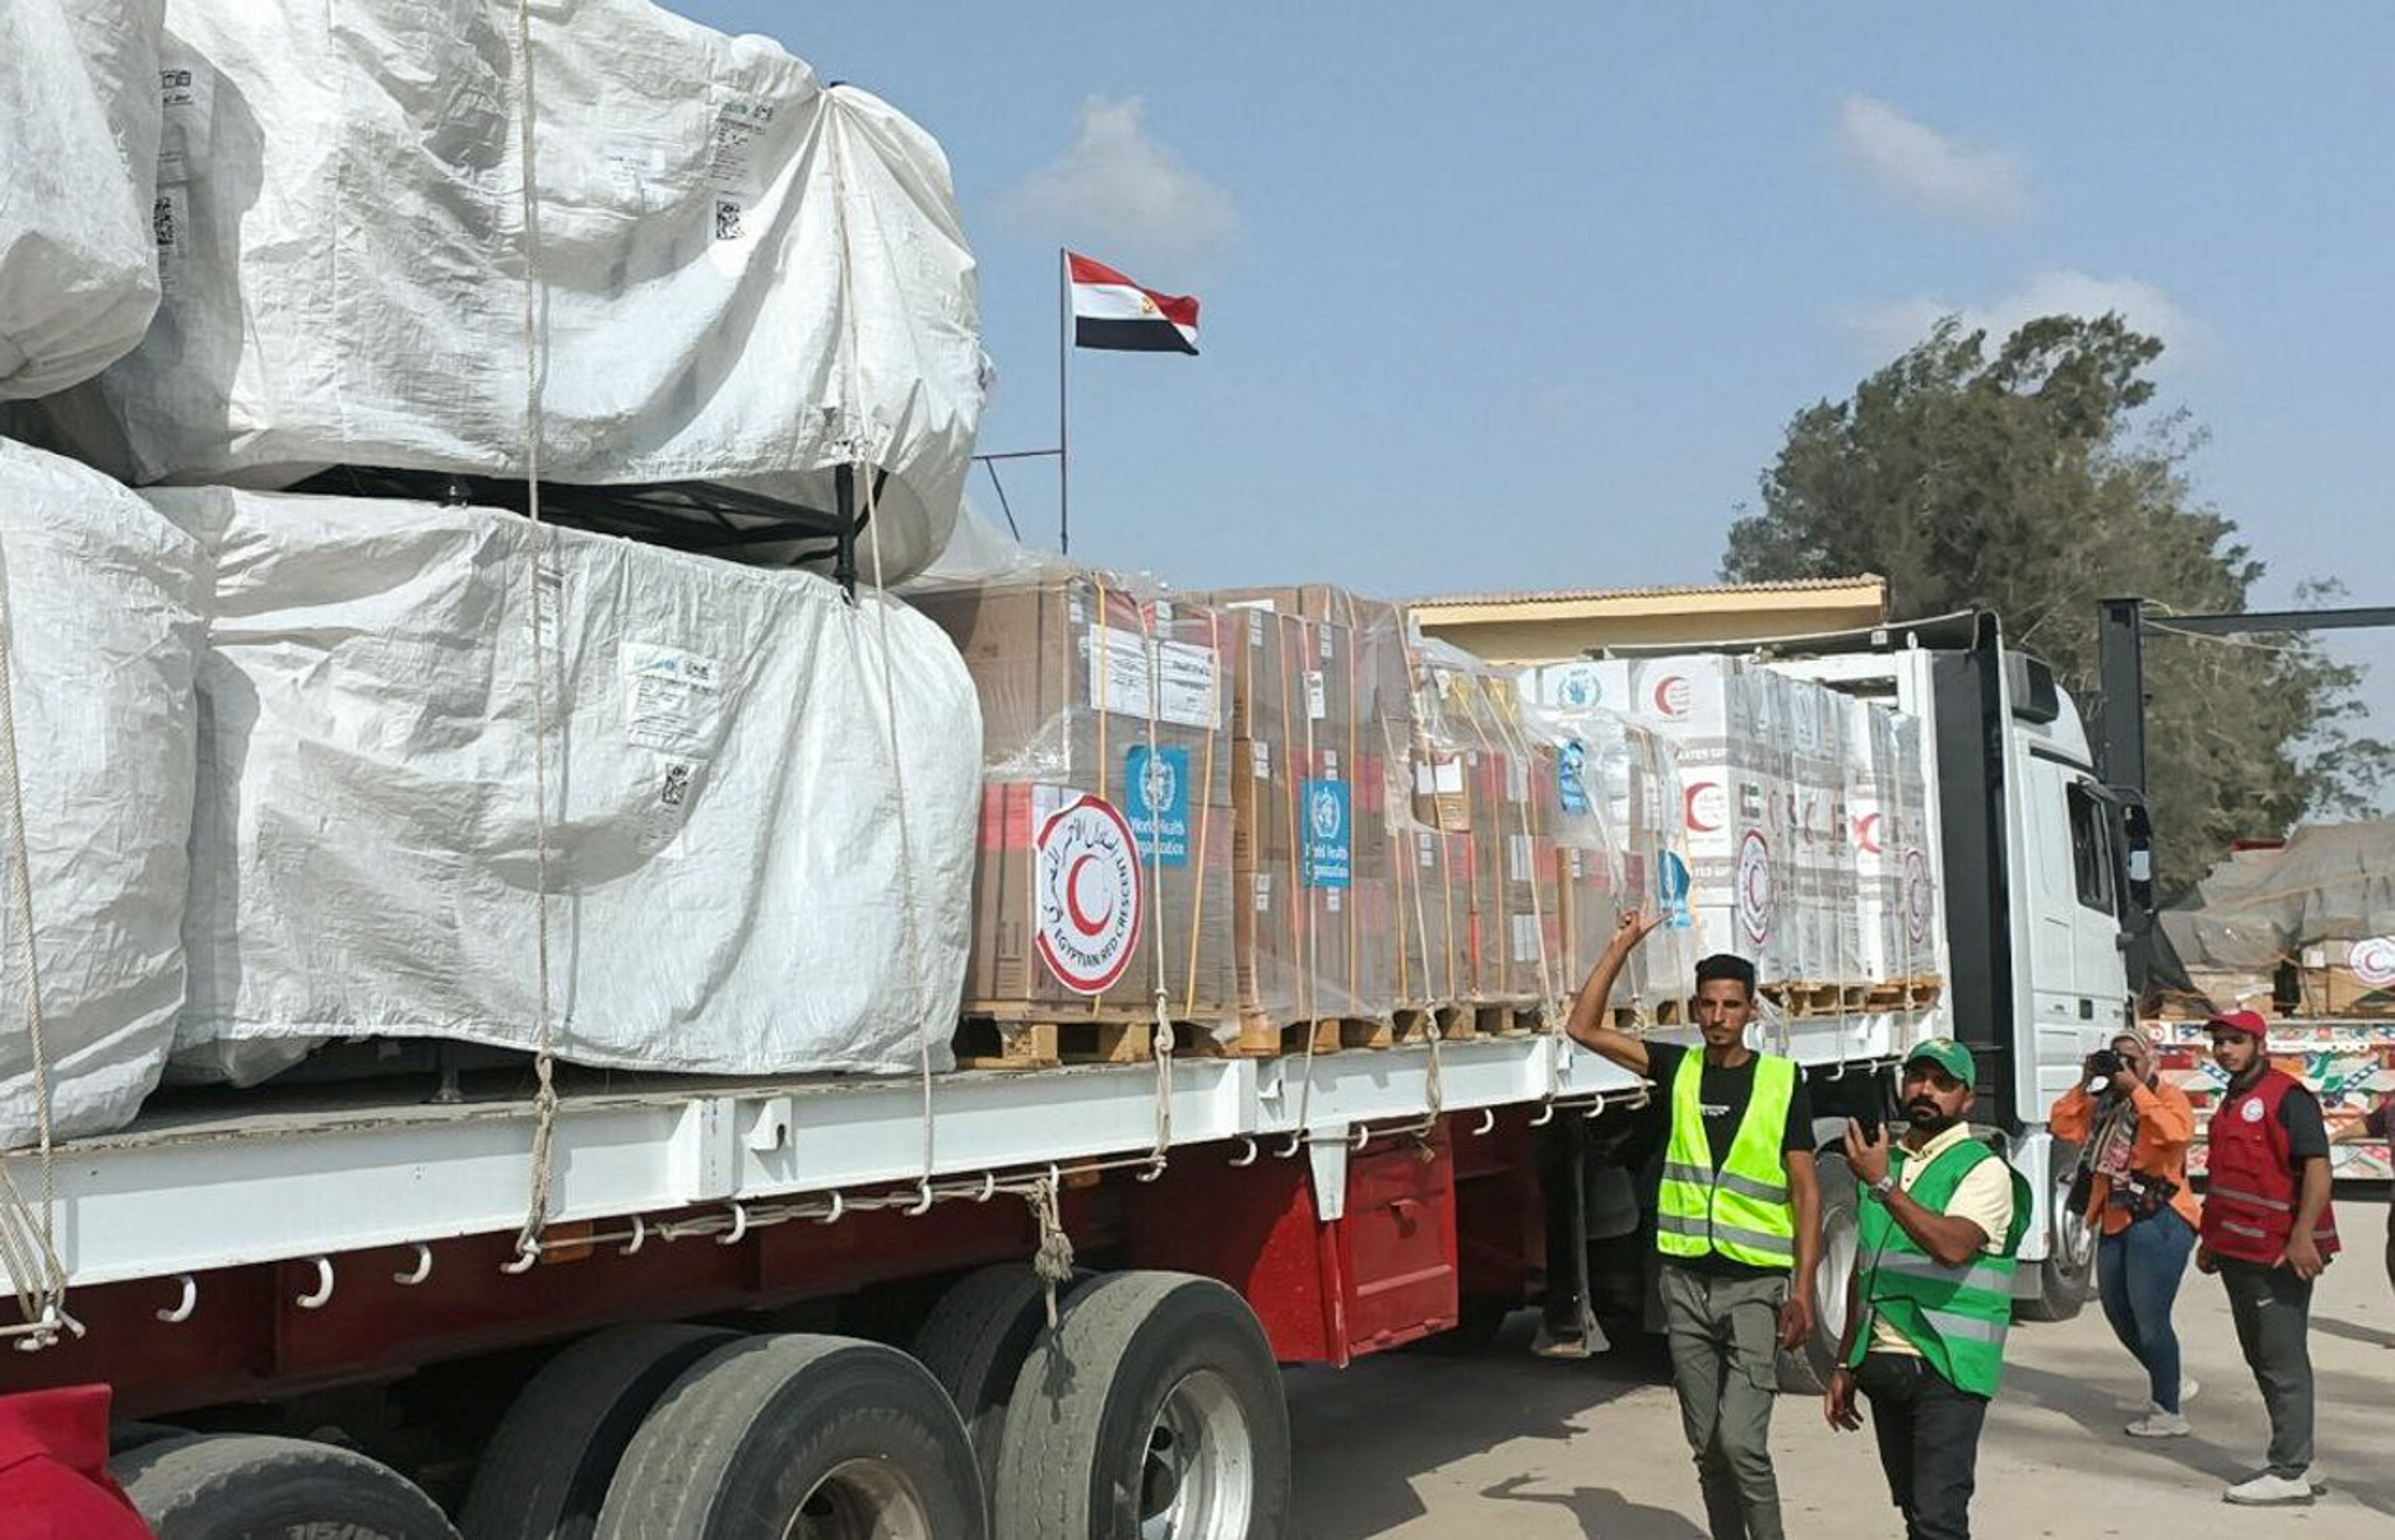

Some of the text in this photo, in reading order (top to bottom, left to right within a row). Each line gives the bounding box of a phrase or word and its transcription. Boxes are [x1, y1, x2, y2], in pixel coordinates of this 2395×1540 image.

[1054, 857, 1131, 968] EGYPTIAN RED CRESCENT
